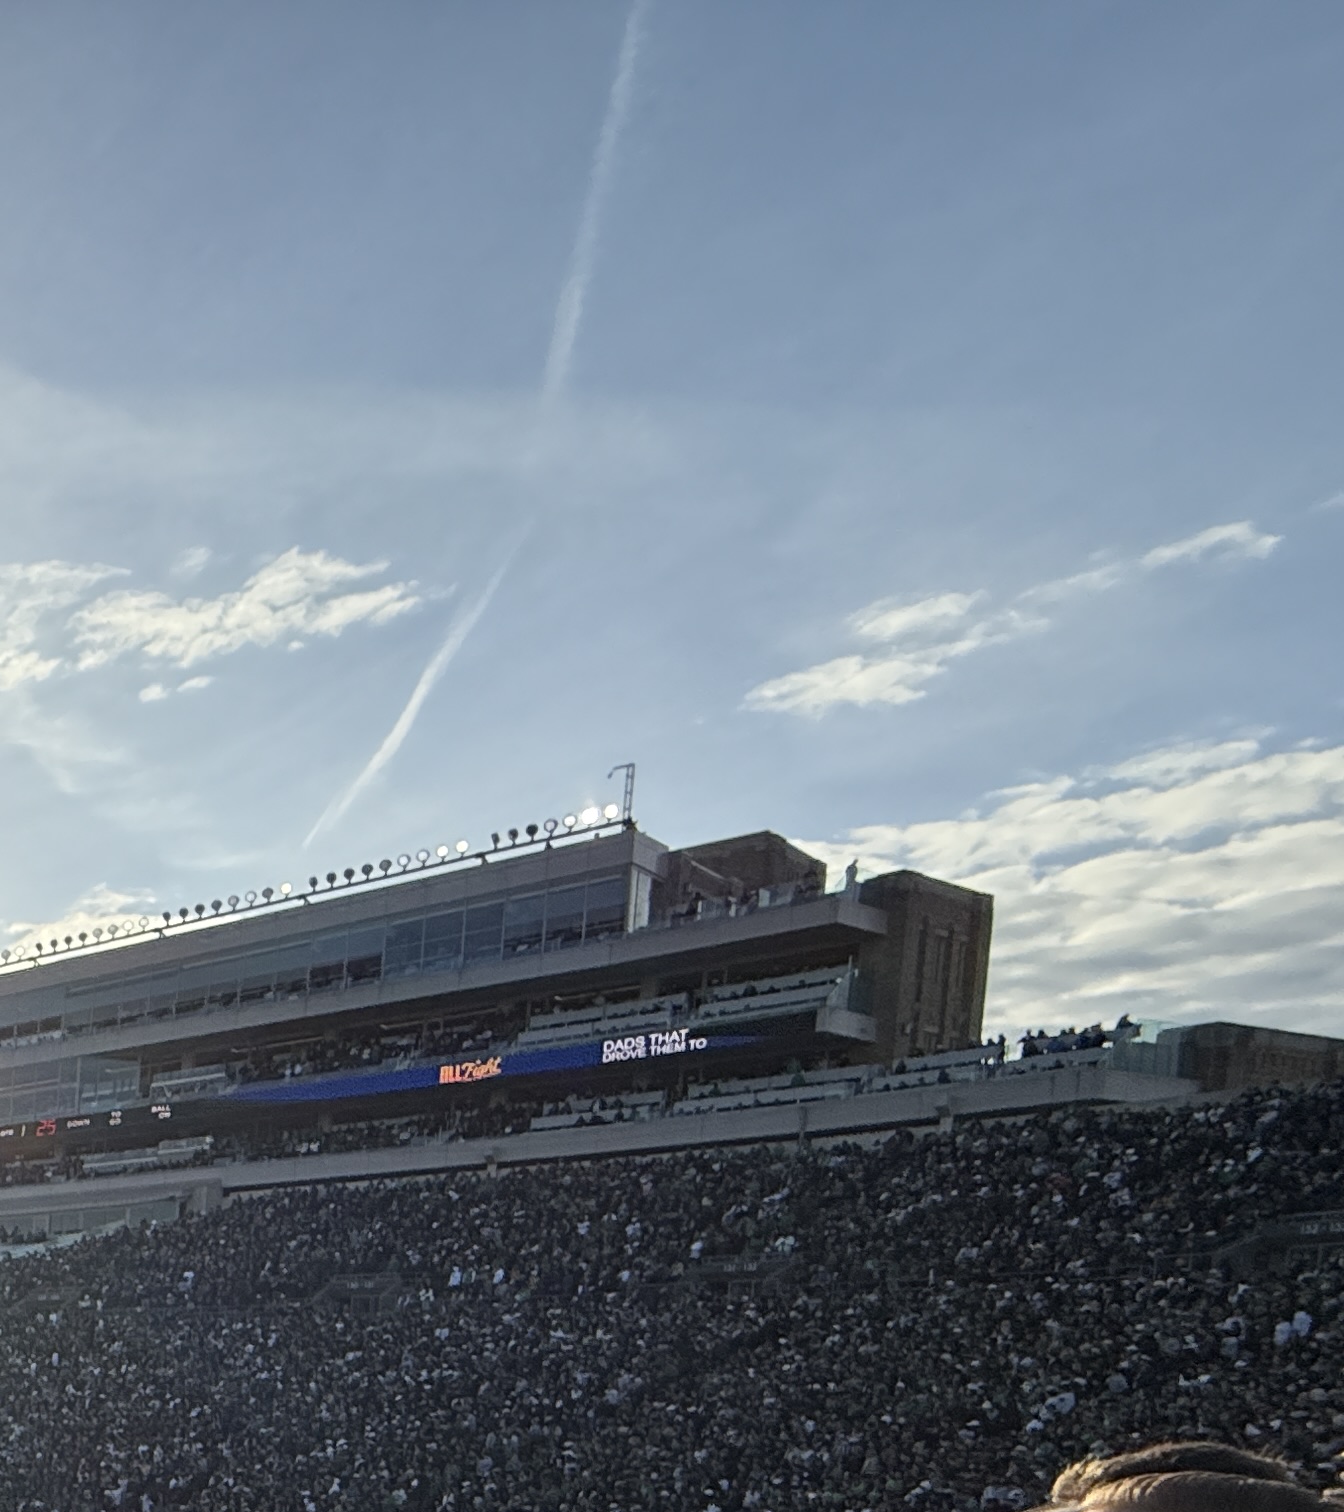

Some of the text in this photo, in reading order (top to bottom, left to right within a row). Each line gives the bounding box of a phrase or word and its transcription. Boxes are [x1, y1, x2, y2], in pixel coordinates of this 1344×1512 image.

[602, 1038, 708, 1063] DROVE THEM TO
[603, 1028, 690, 1052] DADS THAT
[36, 1120, 56, 1137] 25
